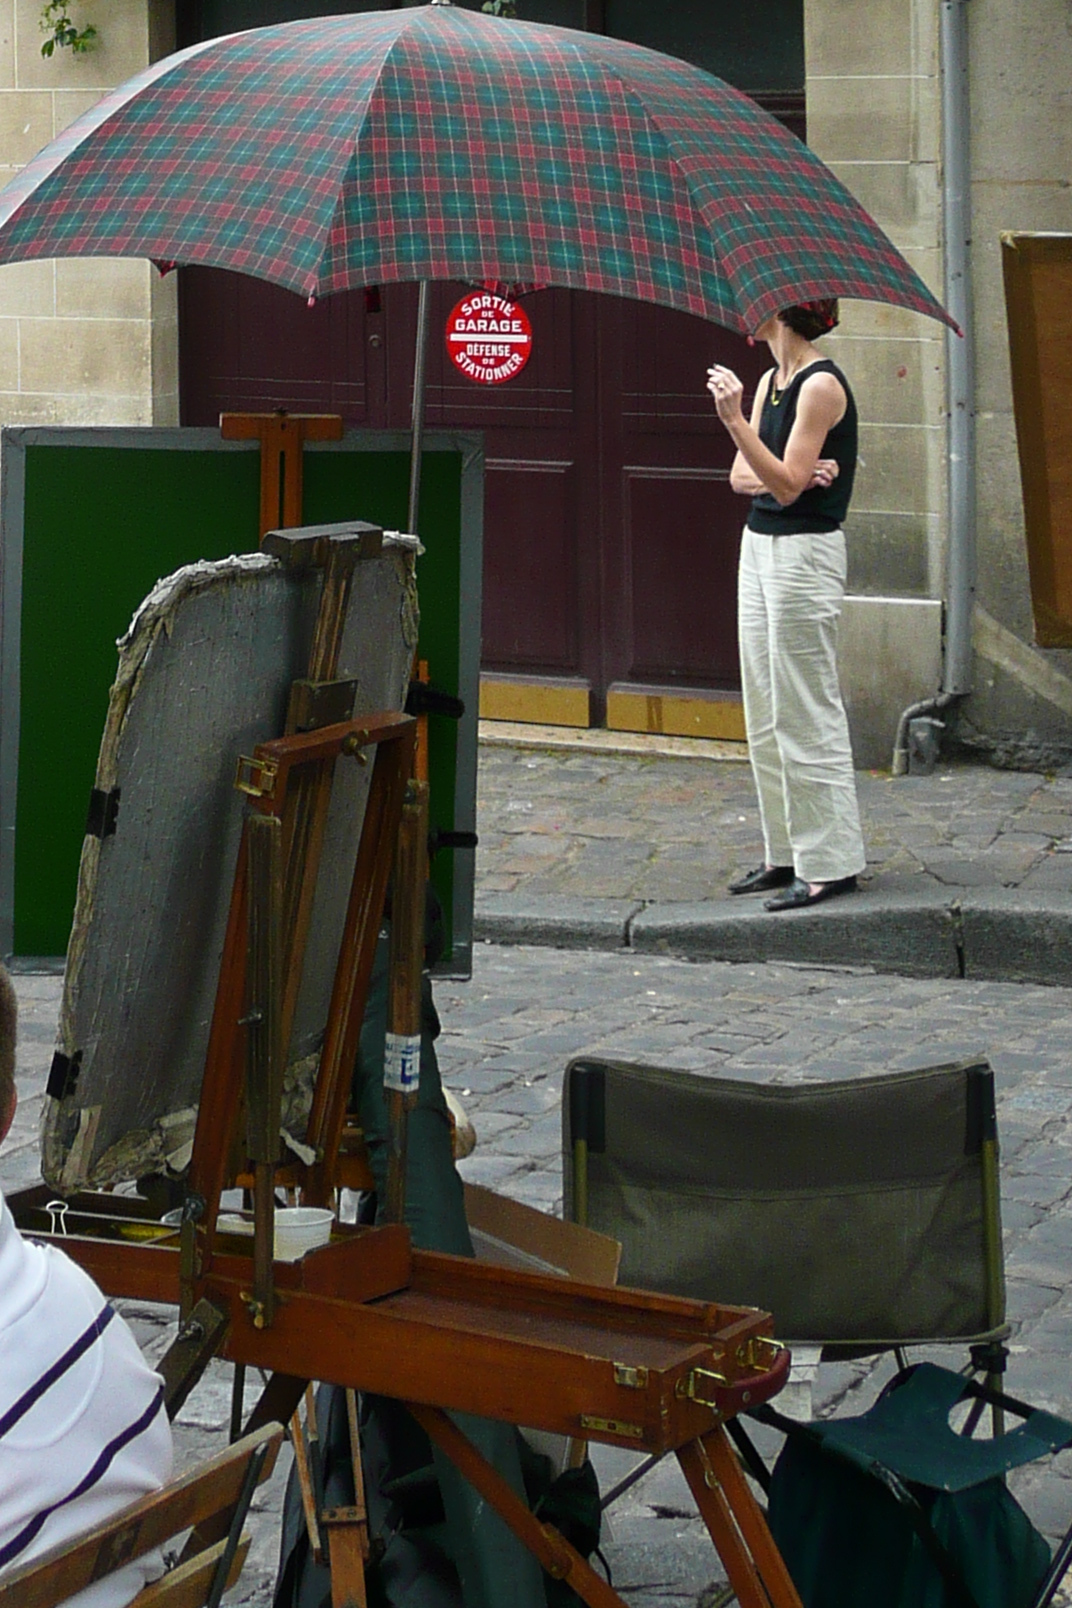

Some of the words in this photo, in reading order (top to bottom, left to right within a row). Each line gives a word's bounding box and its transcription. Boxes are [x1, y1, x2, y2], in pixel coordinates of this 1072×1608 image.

[461, 295, 515, 317] SORTIE
[481, 310, 495, 318] DE
[455, 319, 522, 332] GARAGE
[455, 352, 524, 381] STATIONNER
[482, 357, 495, 365] DE
